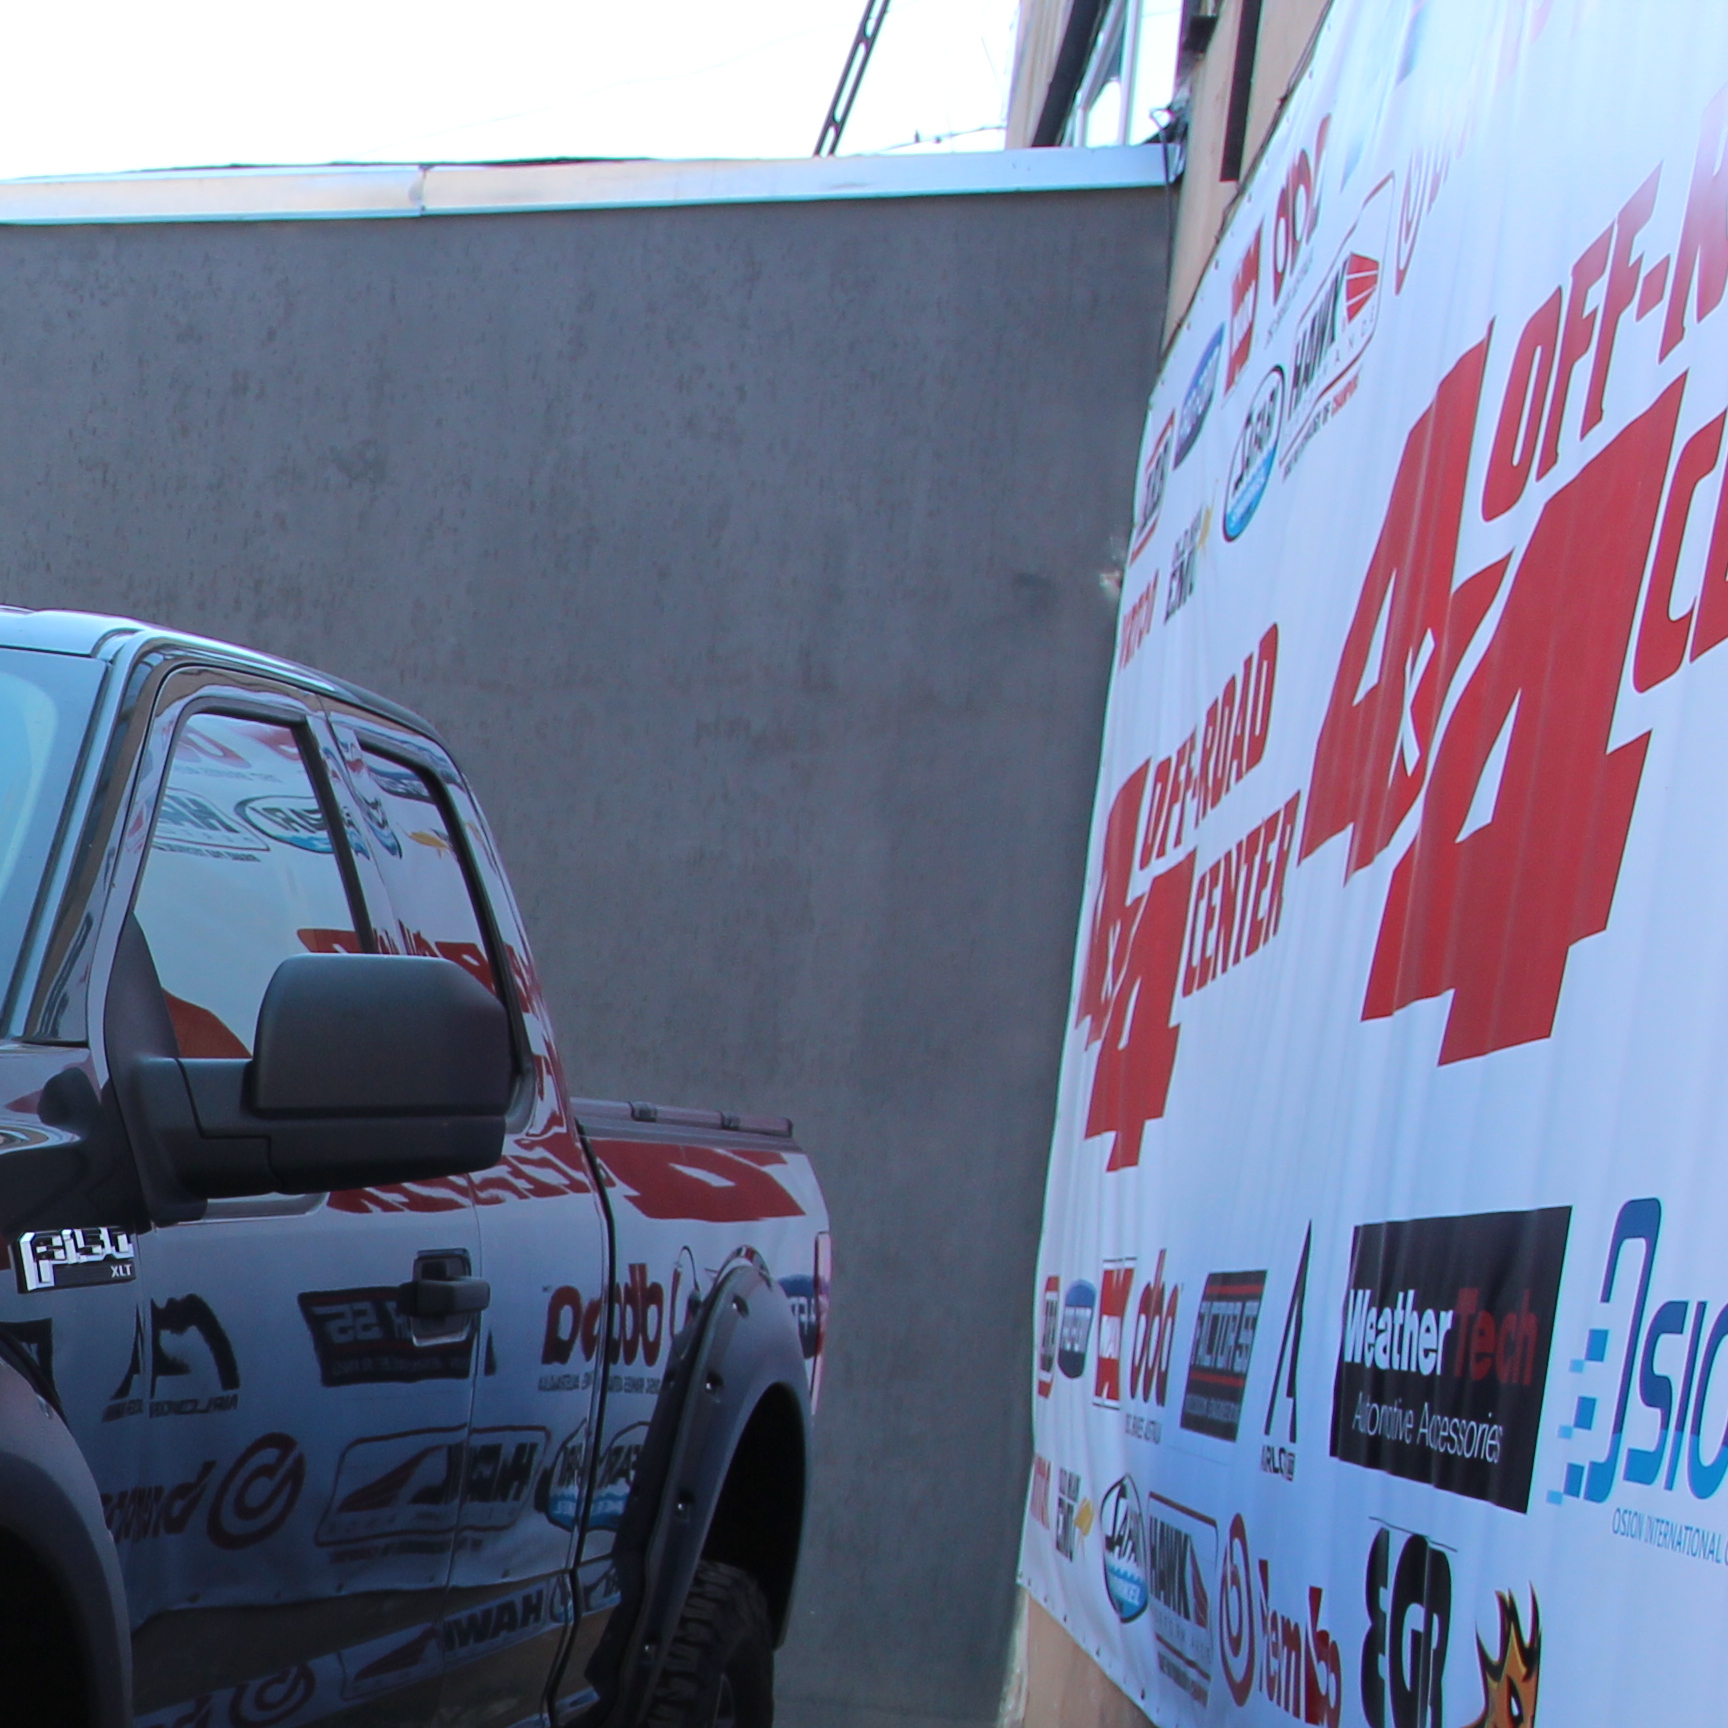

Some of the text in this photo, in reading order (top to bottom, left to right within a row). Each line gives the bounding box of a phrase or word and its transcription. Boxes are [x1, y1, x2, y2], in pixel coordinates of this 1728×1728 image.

[1139, 622, 1278, 871] OFF-ROAD
[1181, 789, 1301, 998] CENTER
[110, 1264, 132, 1278] XLT
[1345, 1287, 1538, 1386] WeatherTech
[1352, 1391, 1503, 1465] Automotive Accessories
